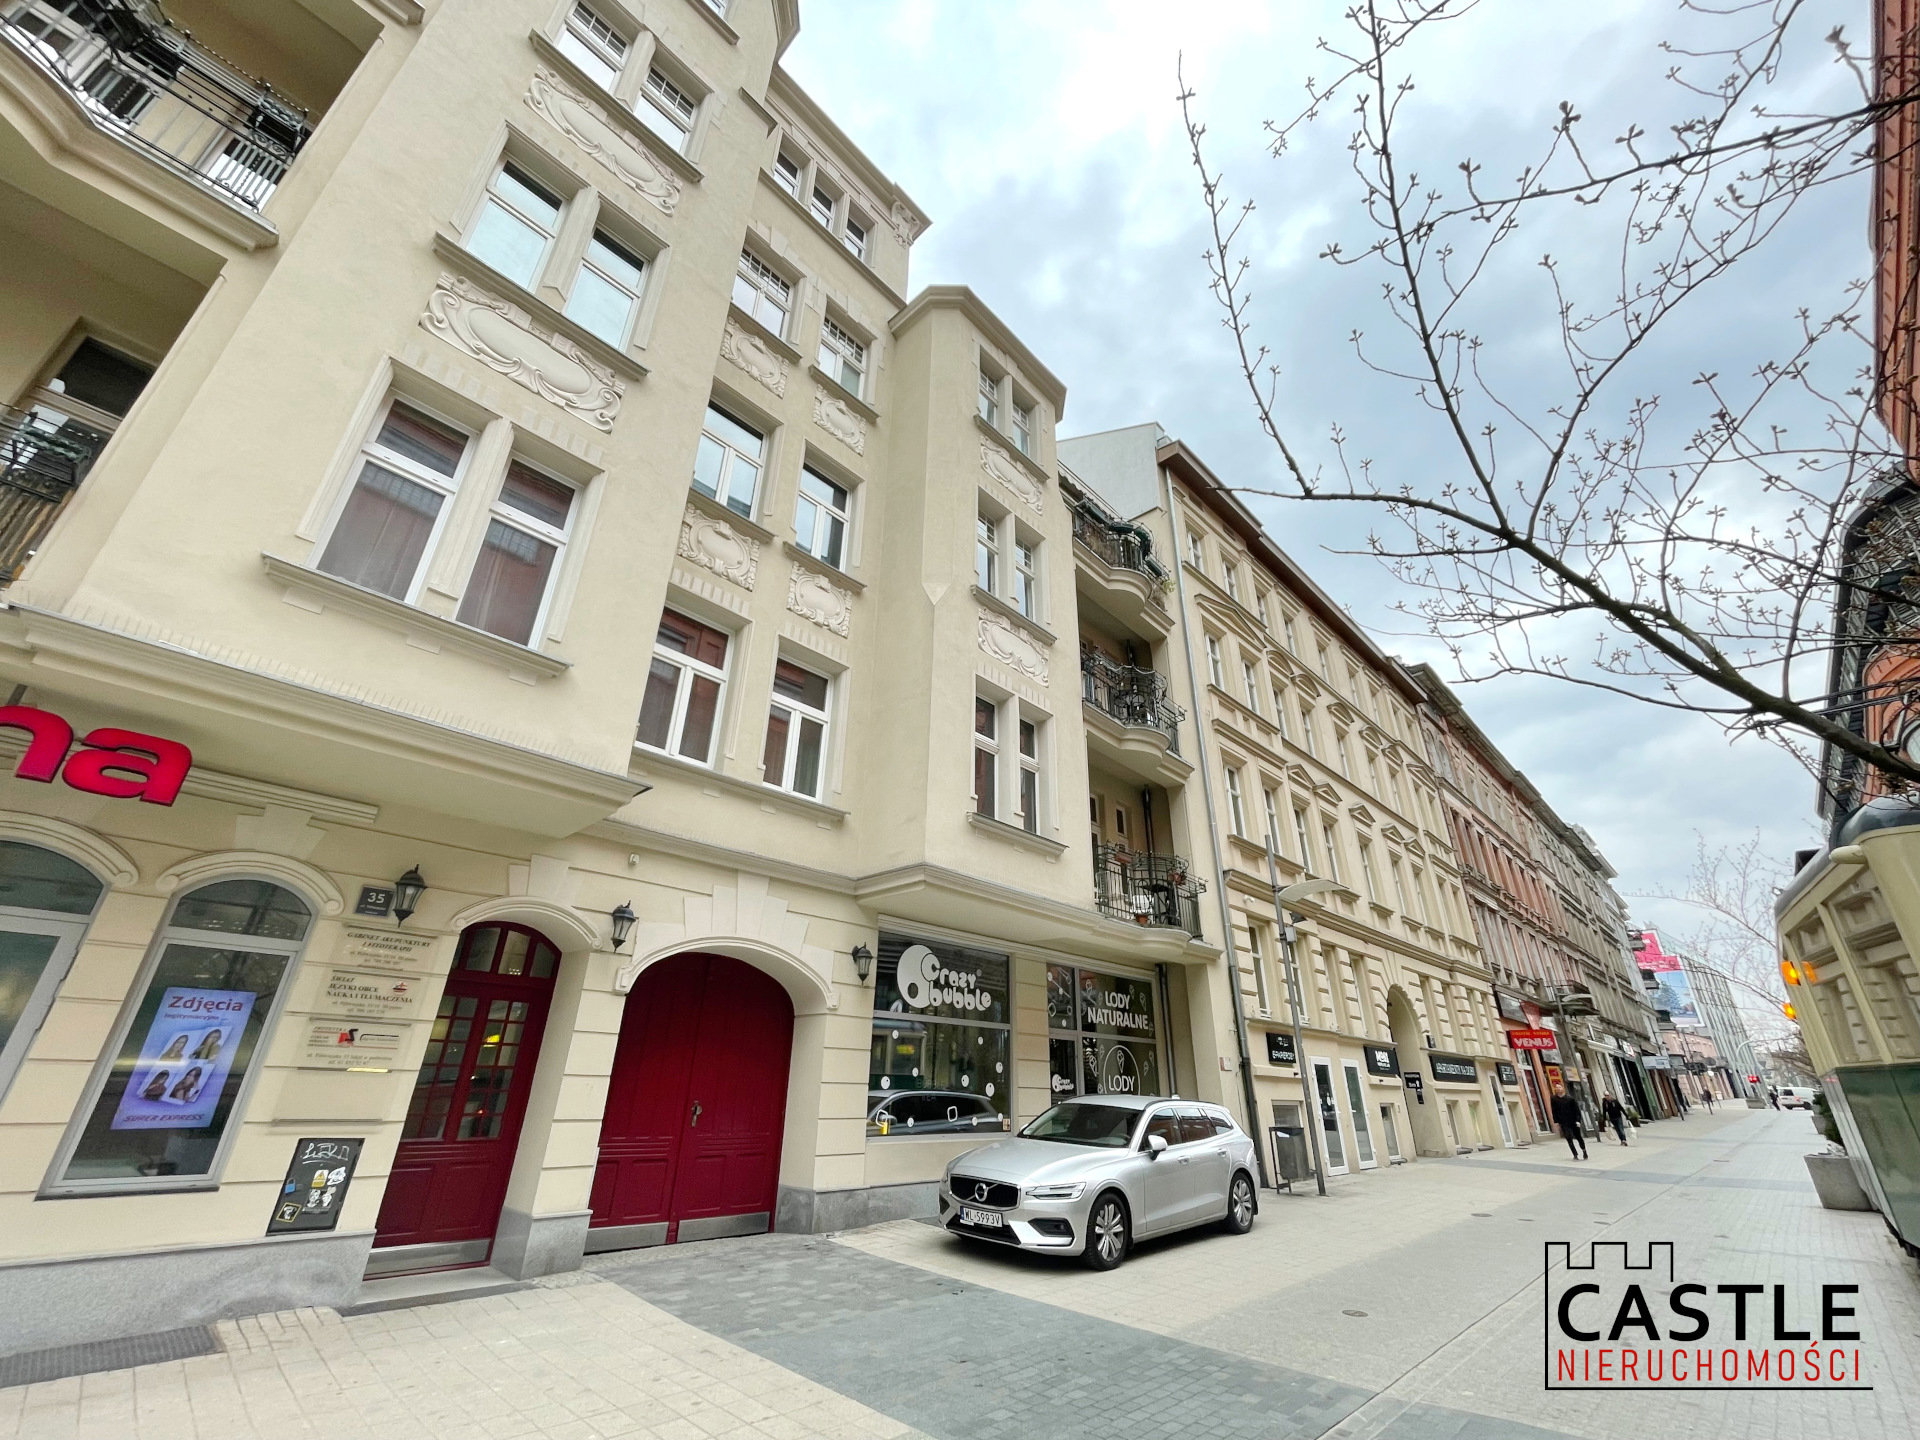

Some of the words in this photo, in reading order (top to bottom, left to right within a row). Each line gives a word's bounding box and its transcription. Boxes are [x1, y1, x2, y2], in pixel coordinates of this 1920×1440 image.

[367, 892, 386, 904] 35
[168, 995, 244, 1013] Zdjęcia
[929, 980, 991, 1012] bubble
[1105, 990, 1131, 1010] LODY
[1087, 1007, 1149, 1030] NATURALNE
[1513, 1037, 1554, 1047] VENUS
[1108, 1074, 1135, 1092] LODY
[123, 1114, 158, 1122] SUPER
